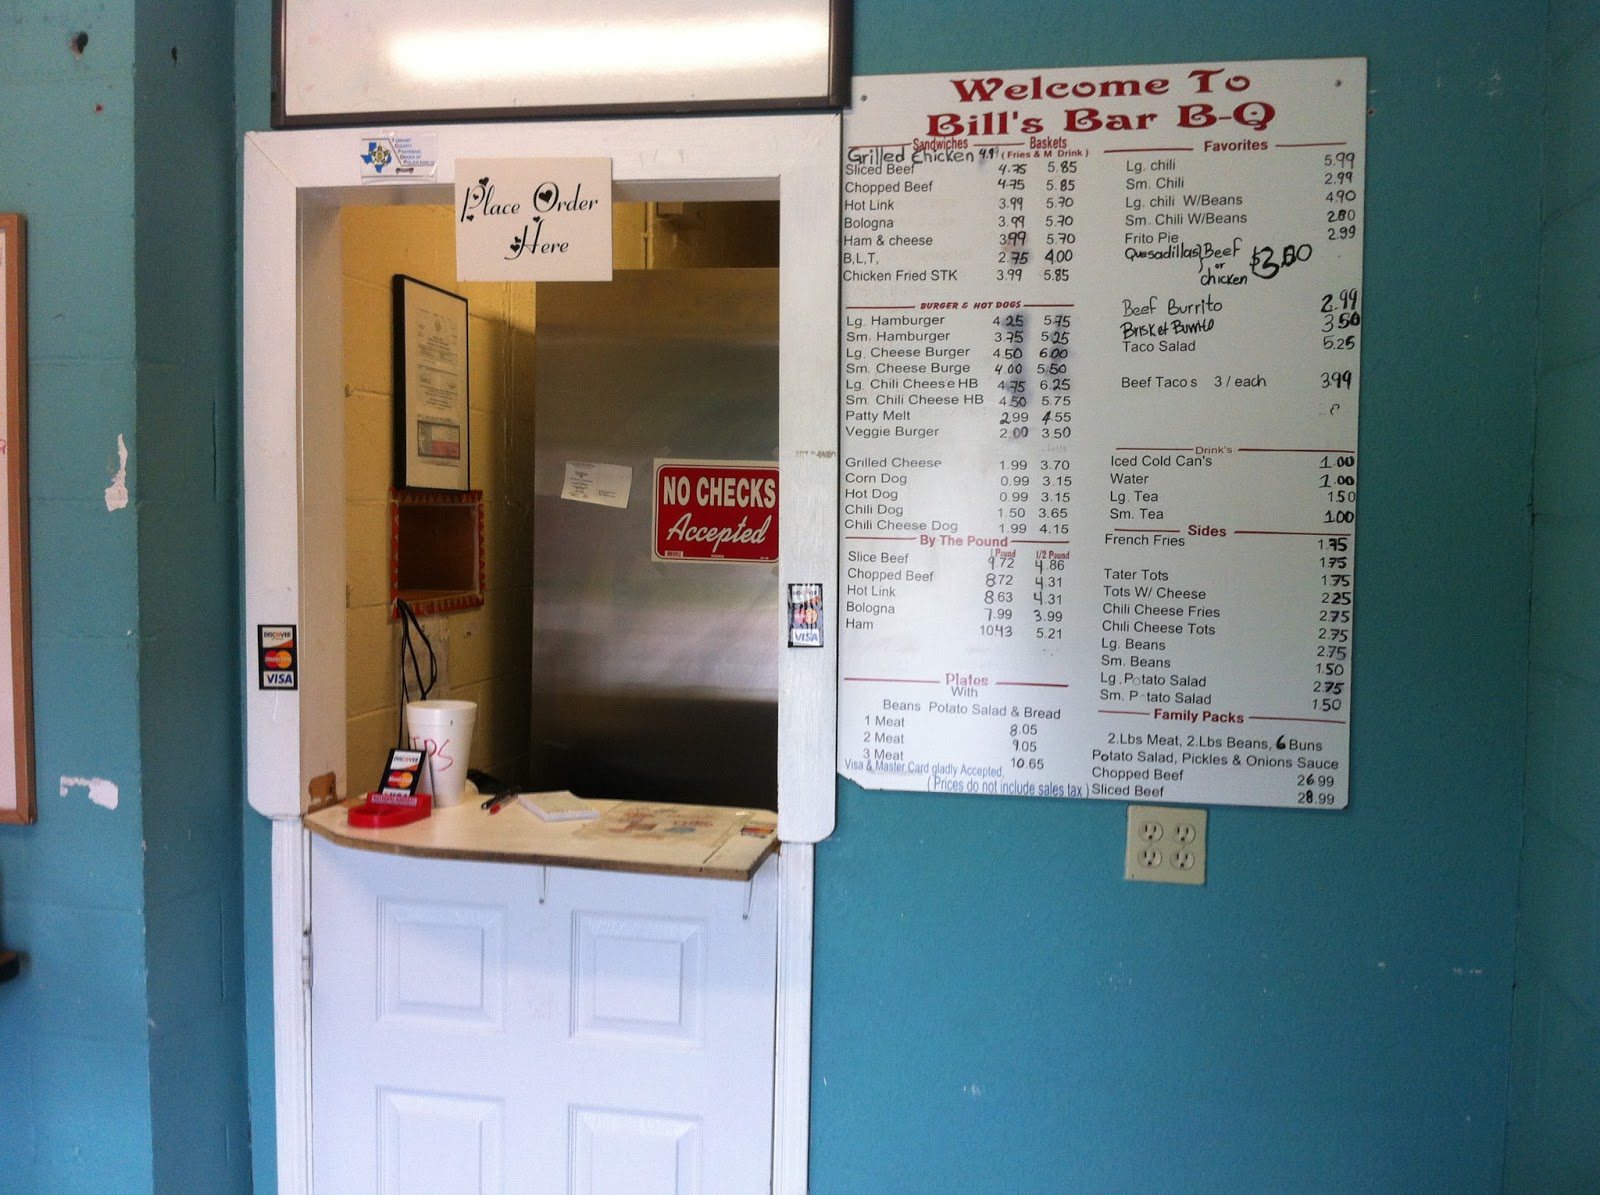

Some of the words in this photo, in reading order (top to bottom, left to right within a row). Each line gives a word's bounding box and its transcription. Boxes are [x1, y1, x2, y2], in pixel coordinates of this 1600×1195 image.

[950, 76, 1170, 102] Welcome
[1188, 68, 1250, 93] To
[926, 111, 1044, 137] Bill's
[1063, 109, 1158, 131] Bar
[1177, 101, 1276, 131] B-Q
[913, 138, 968, 150] Sandwiches
[1030, 137, 1067, 149] Baskets
[1204, 140, 1268, 152] Favorites
[848, 147, 905, 168] Grilled
[912, 149, 974, 165] Chicken
[846, 164, 882, 174] Sliced
[887, 164, 914, 174] Beef
[998, 164, 1027, 174] 4.75
[1048, 161, 1076, 173] 5.85
[845, 182, 900, 195] Chopped
[905, 181, 933, 192] Beef
[1047, 179, 1075, 191] 5.85
[1126, 179, 1151, 190] Sm.
[1156, 178, 1184, 189] Chili
[1325, 172, 1353, 185] 2.99
[461, 177, 520, 222] Place
[533, 181, 598, 213] Order
[845, 200, 866, 210] Hot
[870, 199, 894, 210] Link
[999, 197, 1023, 210] 3.99
[1047, 197, 1073, 208] 5.70
[844, 218, 893, 230] Bologna
[999, 216, 1024, 228] 3.99
[1046, 216, 1073, 227] 5.70
[504, 219, 568, 260] Here
[1125, 233, 1154, 244] Frito
[1158, 233, 1179, 243] Pie
[1328, 225, 1356, 240] 2.99
[1205, 238, 1242, 258] Beef
[843, 270, 891, 282] Chicken
[896, 270, 926, 281] Fried
[931, 270, 957, 280] STK
[997, 270, 1022, 281] 3.99
[1044, 269, 1069, 282] 5.85
[996, 301, 1021, 309] DOGS
[1122, 296, 1157, 317] Beef
[1168, 294, 1223, 315] Burrito
[1321, 288, 1357, 313] 2.99
[871, 315, 945, 328] Hamburger
[993, 315, 1023, 327] 4.25
[1044, 315, 1070, 327] 5.75
[846, 395, 869, 405] Sm.
[876, 394, 904, 405] Chili
[909, 395, 959, 405] Cheese
[964, 395, 984, 405] HB
[999, 395, 1027, 408] 4.50
[1042, 395, 1071, 406] 5.75
[846, 426, 890, 439] Veggie
[895, 427, 939, 439] Burger
[1000, 427, 1028, 439] 2.00
[1042, 427, 1071, 439] 3.50
[1196, 446, 1232, 455] Drink's
[846, 458, 887, 468] Grilled
[892, 458, 941, 468] Cheese
[1000, 460, 1027, 470] 1.99
[1041, 460, 1070, 470] 3.70
[1111, 456, 1137, 466] Iced
[1142, 456, 1171, 467] Cold
[1176, 456, 1212, 466] Can's
[1319, 456, 1355, 469] 1.00
[845, 474, 876, 484] Corn
[882, 474, 907, 485] Dog
[1000, 476, 1029, 486] 0.99
[1043, 476, 1072, 486] 3.15
[1110, 474, 1149, 484] Water
[1319, 475, 1354, 488] 1.00
[663, 476, 690, 506] NO
[697, 478, 776, 508] CHECKS
[845, 489, 868, 499] Hot
[872, 489, 898, 501] Dog
[1000, 492, 1028, 502] 0.99
[1041, 492, 1070, 503] 3.15
[845, 504, 873, 514] Chili
[878, 505, 903, 517] Dog
[998, 508, 1025, 518] 1.50
[1038, 508, 1068, 518] 3.65
[667, 513, 772, 553] Accepted
[845, 520, 872, 530] Chili
[877, 521, 927, 531] Cheese
[932, 521, 958, 532] Dog
[999, 523, 1027, 534] 1.99
[1039, 524, 1069, 534] 4.15
[1188, 525, 1226, 537] Sides
[920, 535, 935, 548] By
[940, 535, 963, 546] The
[968, 536, 1008, 547] Pound
[1320, 557, 1347, 568] 1.75
[1104, 569, 1137, 581] Tater
[1141, 570, 1168, 581] Tots
[1321, 574, 1350, 586] 1.75
[848, 585, 868, 596] Hot
[872, 586, 896, 597] Link
[984, 590, 1013, 605] 8.63
[1034, 593, 1062, 605] 4.31
[846, 602, 895, 615] Bologna
[985, 608, 1012, 621] 7.99
[1034, 610, 1063, 622] 3.99
[1103, 603, 1130, 615] Chili
[1134, 604, 1183, 616] Cheese
[1188, 605, 1220, 618] Fries
[1319, 611, 1350, 623] 2.75
[795, 633, 818, 641] VISA
[1102, 620, 1129, 632] Chili
[1134, 622, 1183, 633] Cheese
[1188, 623, 1215, 635] Tots
[1319, 628, 1348, 640] 2.75
[267, 674, 292, 683] VISA
[946, 673, 988, 686] Plates
[951, 686, 978, 697] With
[883, 699, 921, 712] Beans
[929, 702, 968, 714] Potato
[972, 704, 1007, 716] Salad
[1011, 707, 1019, 717] &
[1024, 707, 1061, 720] Bread
[1154, 709, 1198, 723] Family
[1203, 711, 1244, 723] Packs
[875, 715, 905, 727] Meat
[1010, 724, 1037, 736] 8.05
[845, 759, 863, 771] Visa
[866, 760, 873, 771] &
[875, 761, 905, 773] Master
[908, 762, 929, 773] Card
[932, 763, 958, 779] gladly
[1092, 767, 1149, 781] Chopped
[1154, 769, 1184, 781] Beef
[1297, 774, 1334, 787] 26.99
